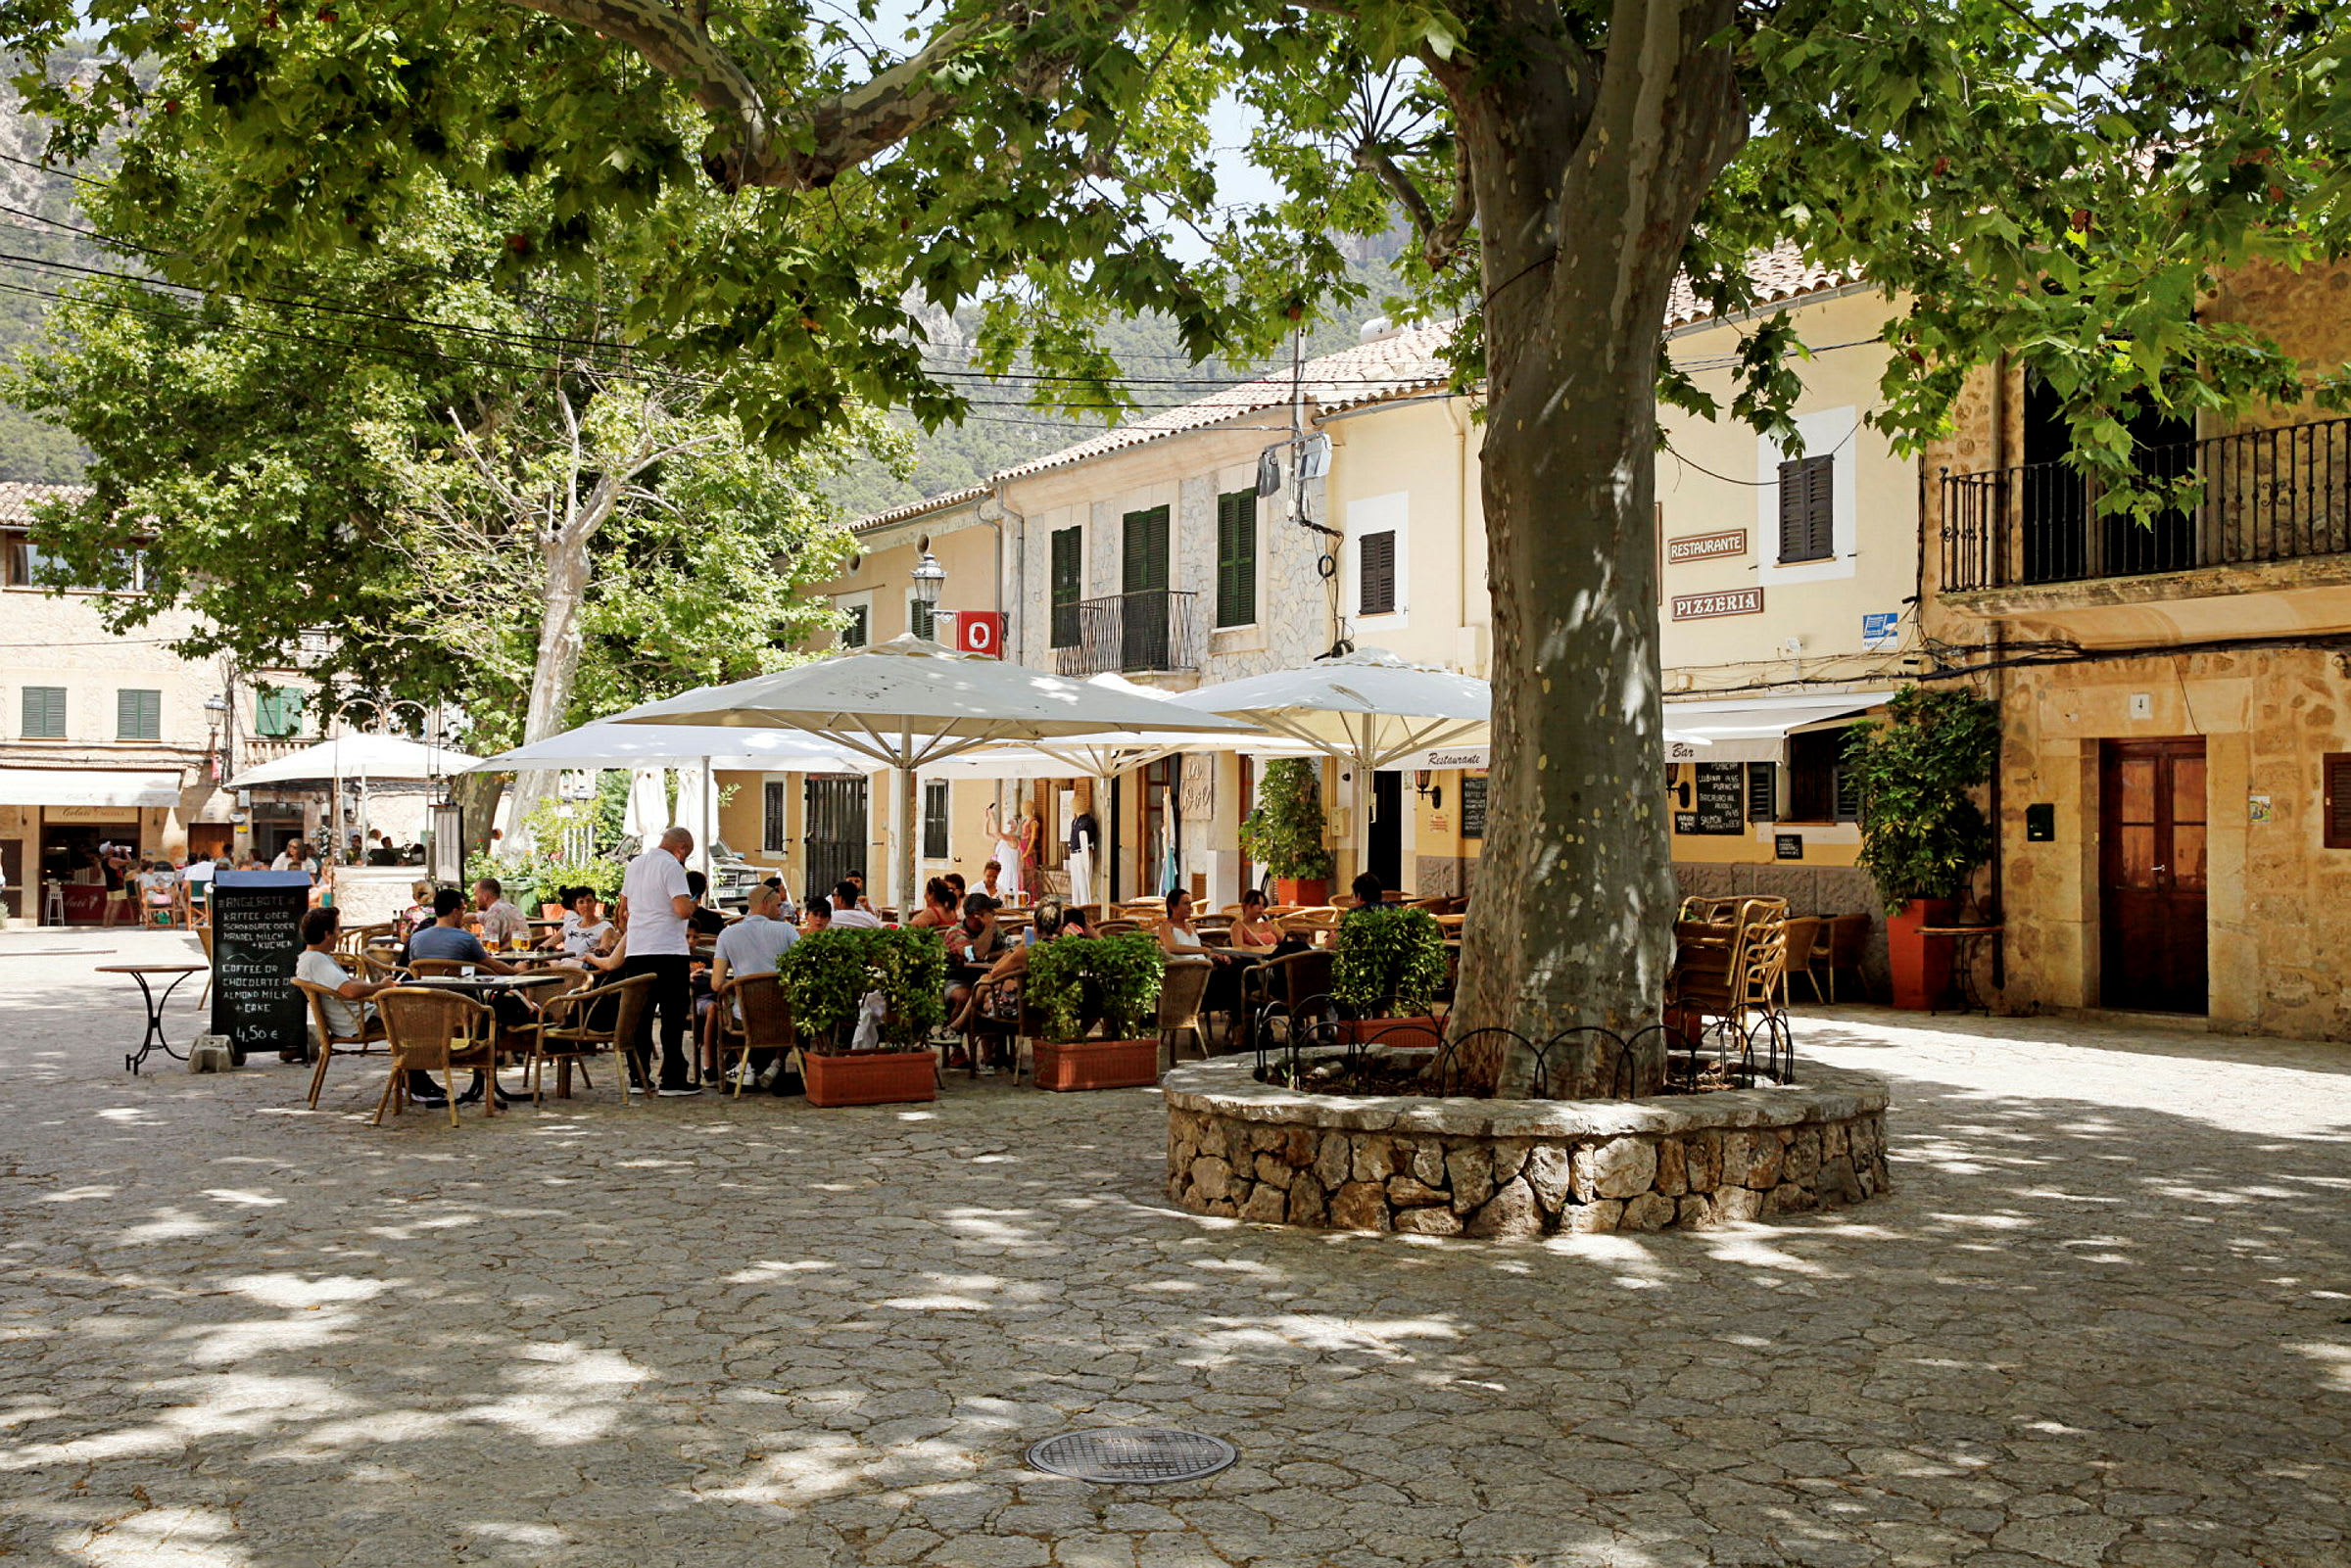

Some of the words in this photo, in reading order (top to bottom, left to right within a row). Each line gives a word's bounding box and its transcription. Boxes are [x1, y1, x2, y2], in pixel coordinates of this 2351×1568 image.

[1671, 536, 1742, 558] RESTAURANTE
[1676, 593, 1756, 616] PIZZERIA
[1672, 742, 1694, 758] Bar
[1428, 752, 1481, 765] Restaurante
[1187, 758, 1203, 780] in
[264, 911, 290, 921] ODER
[223, 931, 253, 941] MANDEL
[256, 932, 284, 941] MILCH
[258, 940, 293, 950] KUCHEN
[222, 964, 263, 974] COFFEE
[264, 965, 279, 974] OR
[222, 977, 280, 987] CHOCOLATE
[262, 990, 290, 1000] MILK
[244, 1003, 271, 1013] CAKE
